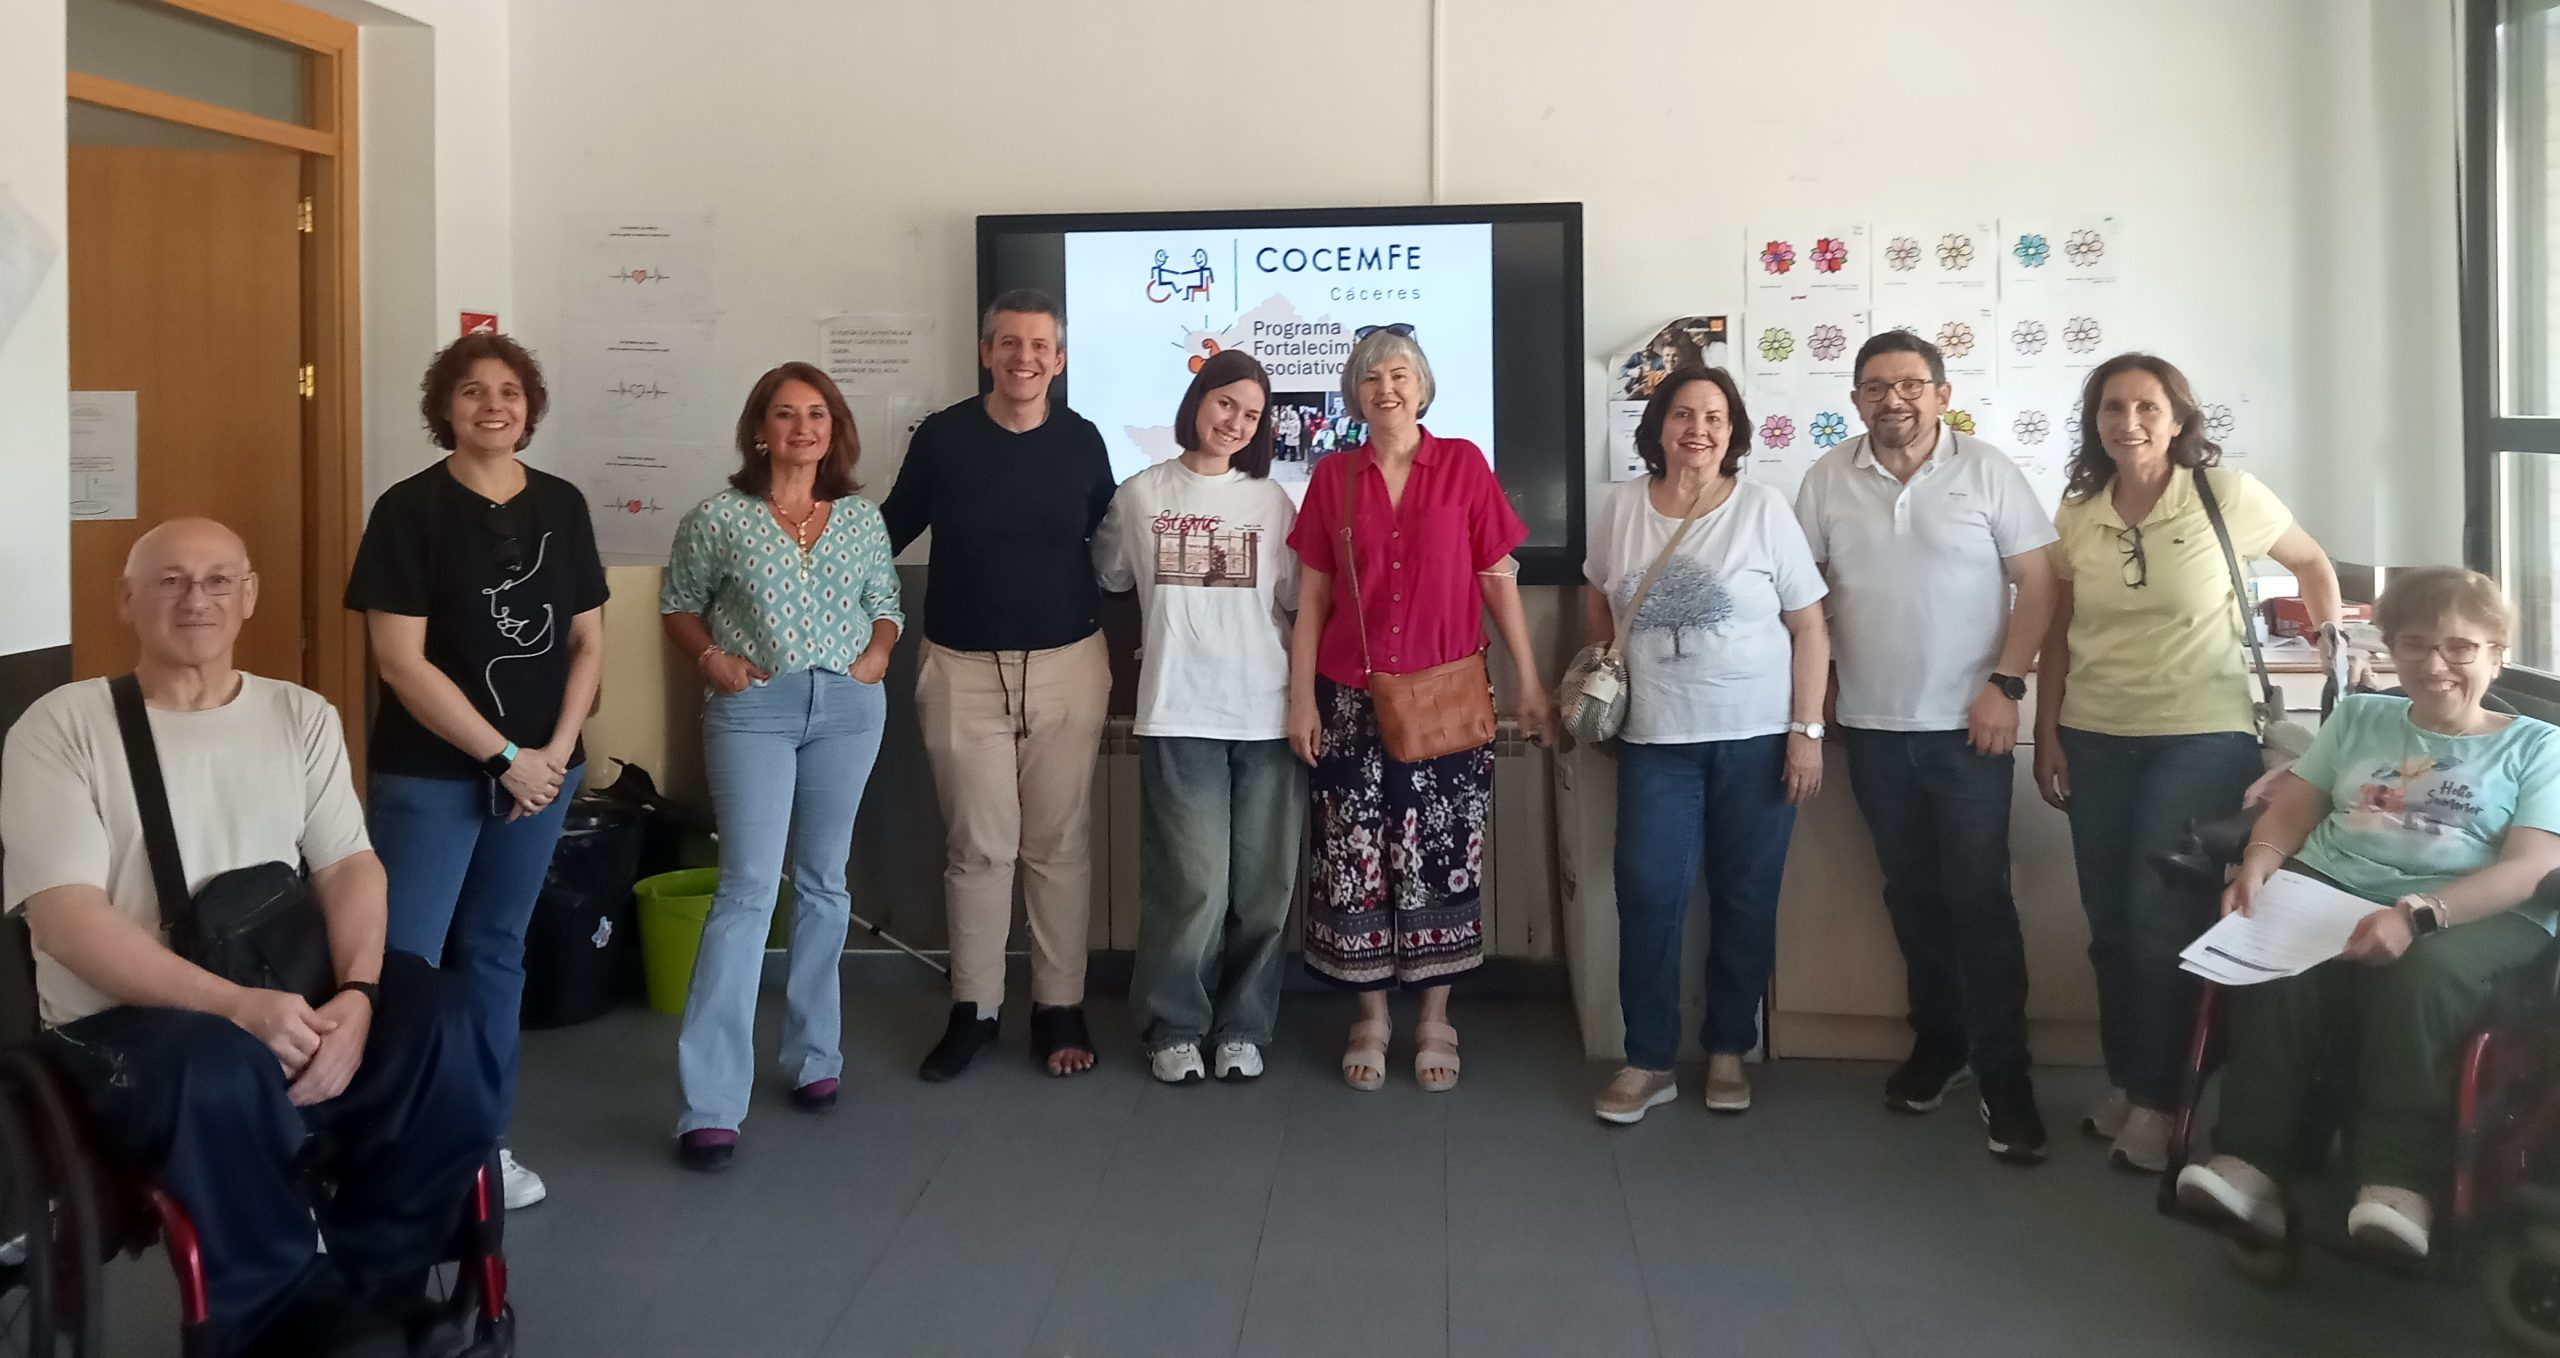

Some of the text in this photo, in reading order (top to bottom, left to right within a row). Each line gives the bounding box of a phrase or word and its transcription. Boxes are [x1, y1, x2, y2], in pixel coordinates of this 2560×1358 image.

[1256, 244, 1421, 273] COCEMFE
[1330, 287, 1421, 301] Cáceres
[1253, 320, 1341, 339] Programa
[1262, 360, 1346, 375] sociativo
[2440, 780, 2475, 799] Hello
[2424, 788, 2485, 816] Summer
